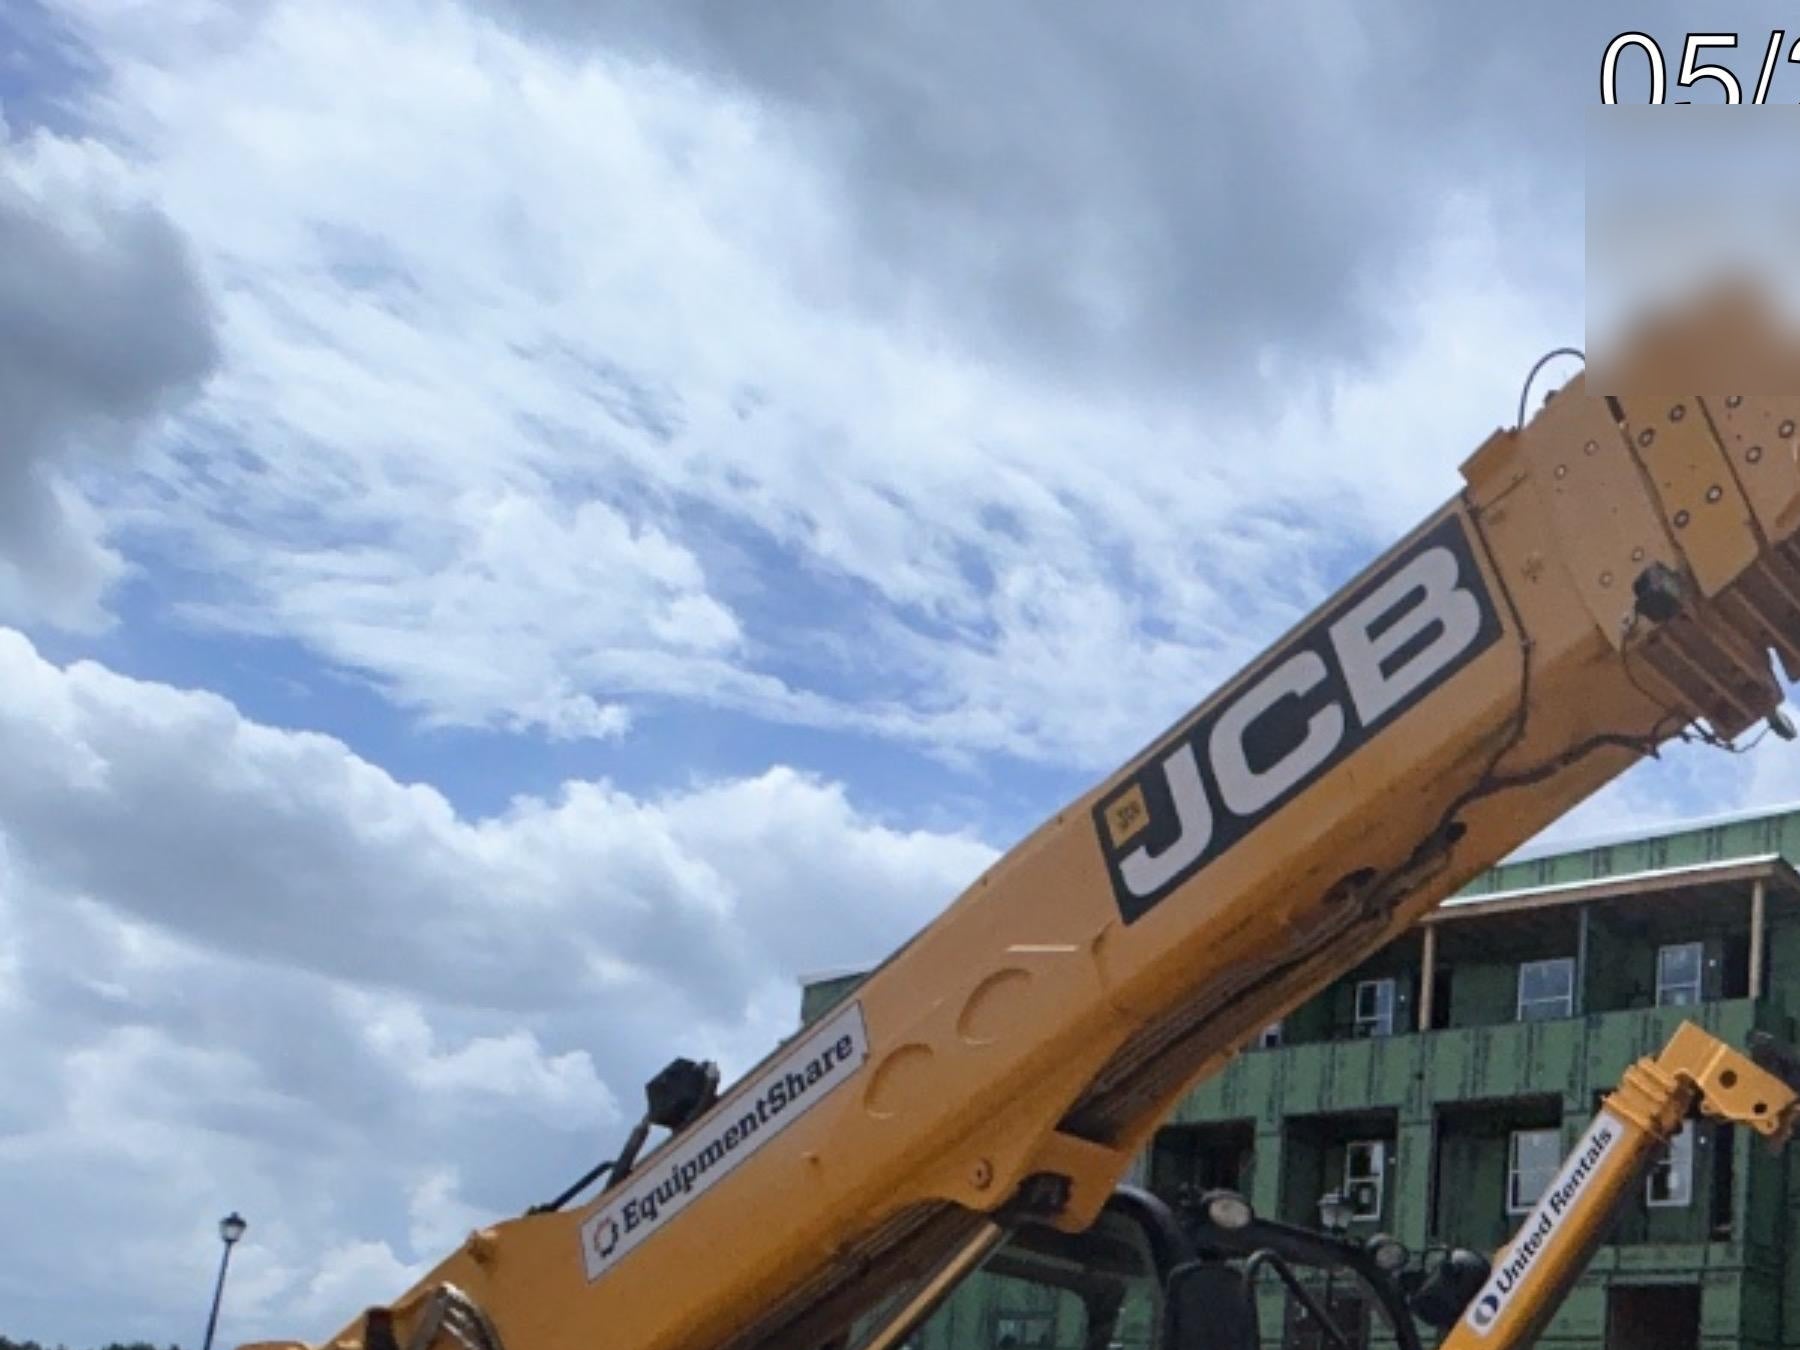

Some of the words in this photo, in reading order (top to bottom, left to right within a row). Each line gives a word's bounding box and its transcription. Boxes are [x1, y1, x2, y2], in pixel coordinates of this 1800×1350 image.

[1118, 546, 1482, 897] JCB
[622, 1033, 854, 1234] EquipmentShare
[1496, 1211, 1554, 1294] United
[1550, 1128, 1613, 1215] Rentals
